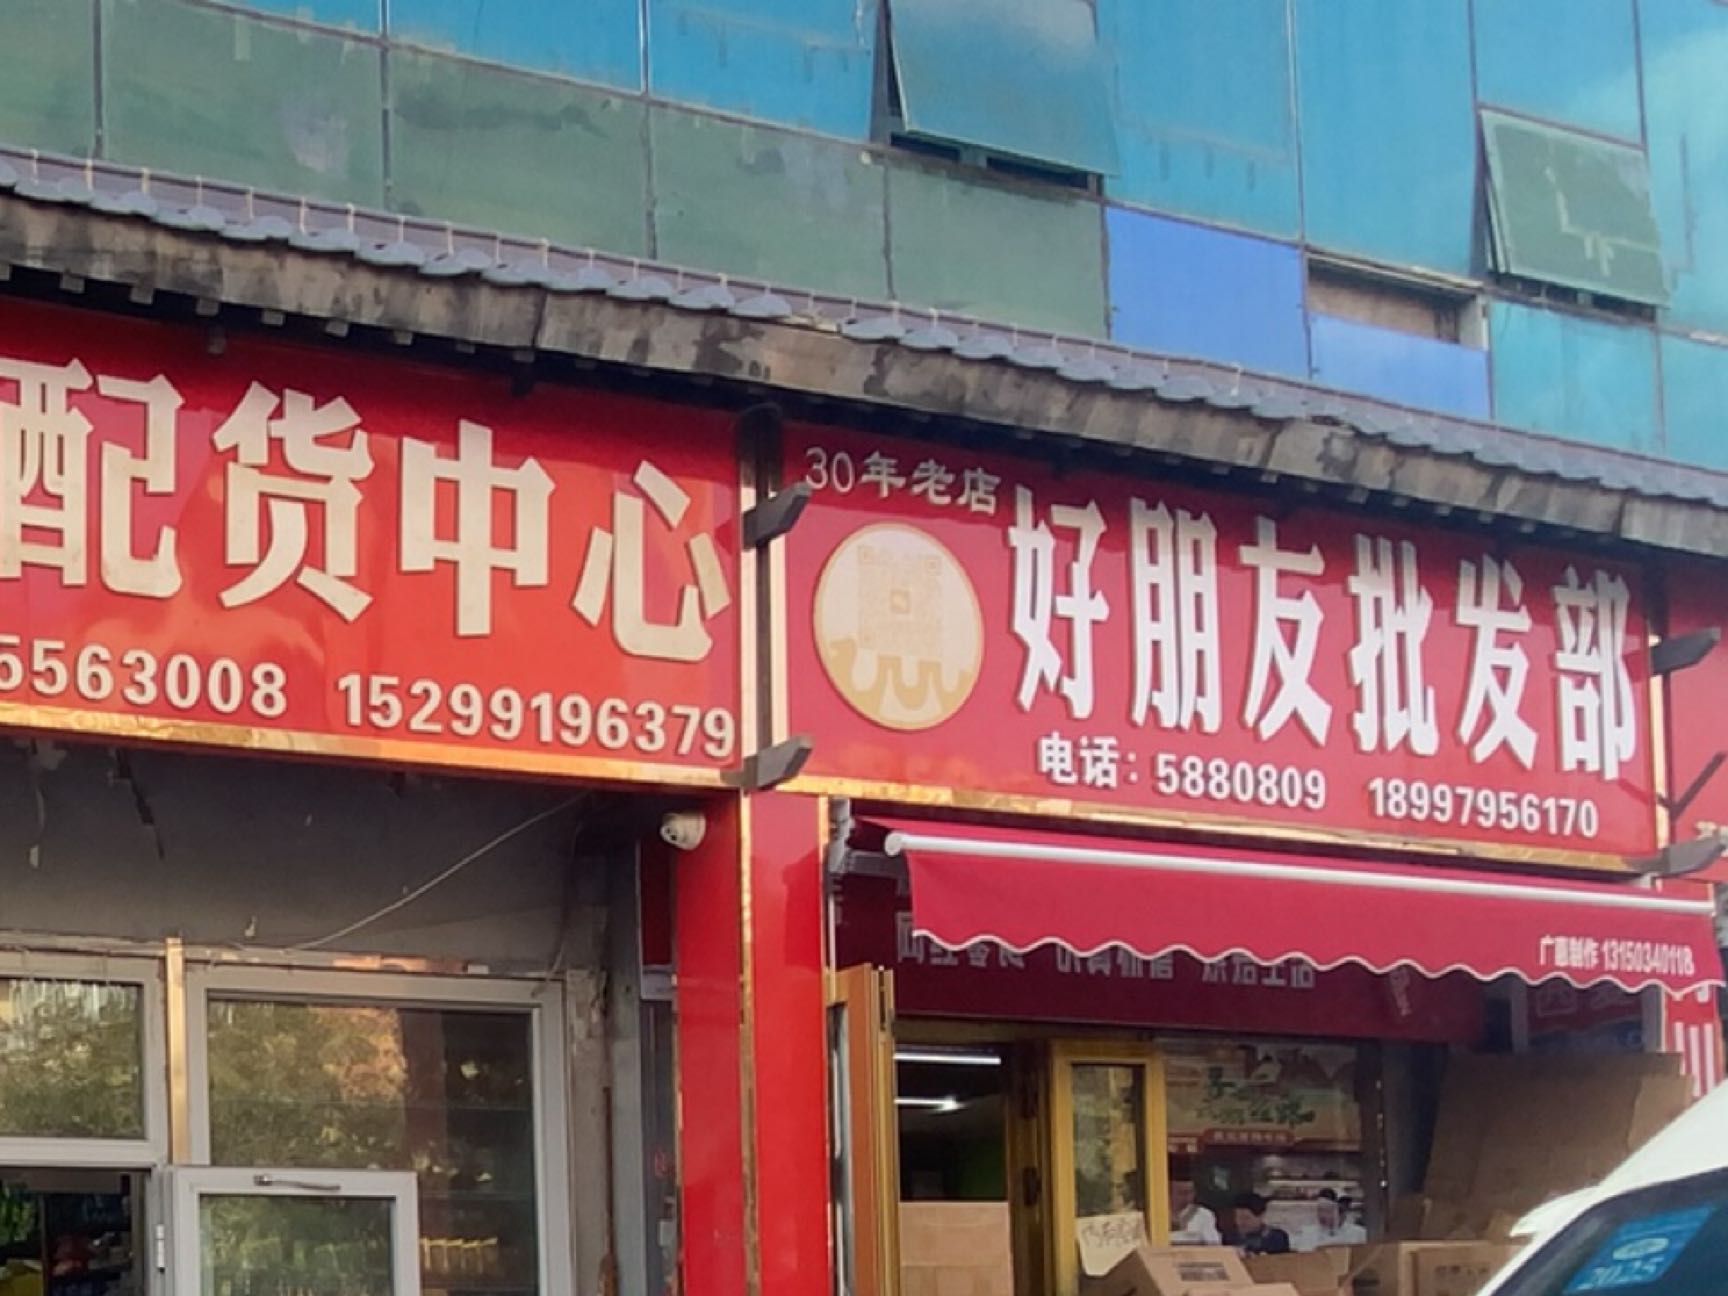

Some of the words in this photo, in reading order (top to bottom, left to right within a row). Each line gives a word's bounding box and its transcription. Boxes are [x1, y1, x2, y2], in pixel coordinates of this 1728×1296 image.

[803, 446, 1002, 513] 30年老店
[1008, 484, 1637, 780] 好朋友批发部
[337, 673, 736, 758] 15299196379
[1369, 776, 1599, 838] 18997956170
